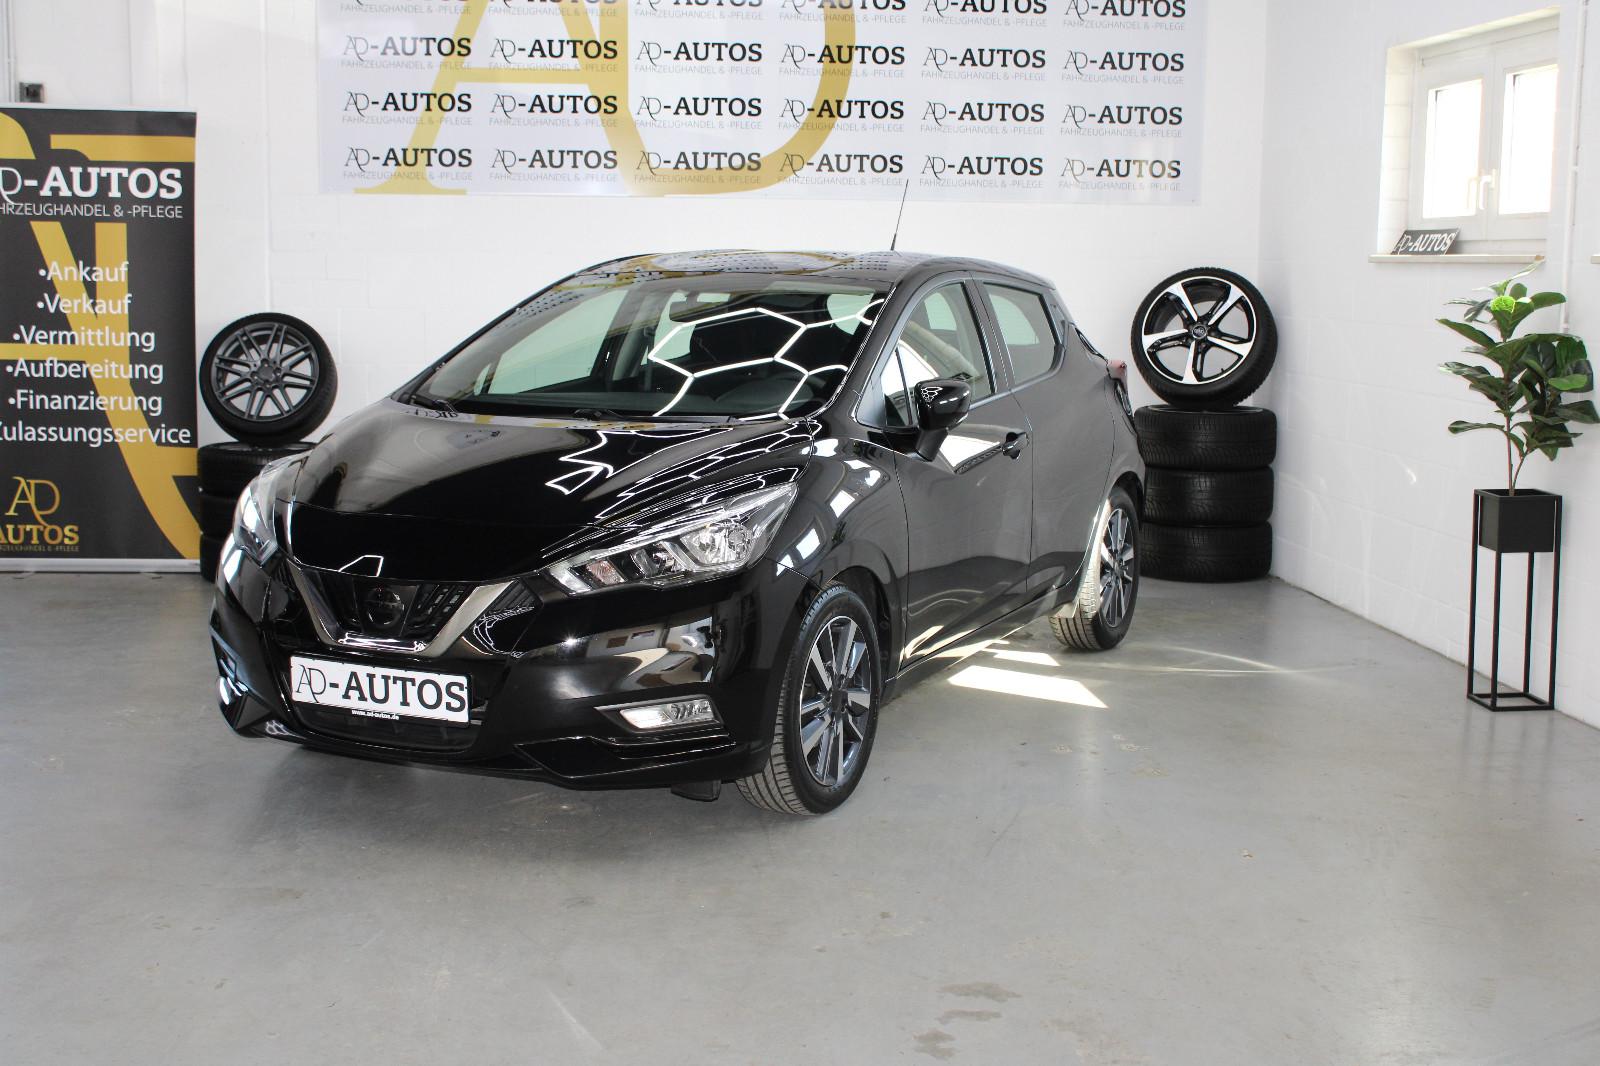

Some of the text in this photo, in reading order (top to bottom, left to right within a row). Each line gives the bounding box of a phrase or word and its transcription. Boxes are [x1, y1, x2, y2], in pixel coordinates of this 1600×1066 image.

[340, 4, 424, 14] FAHRZEUGHANDEL
[488, 6, 572, 16] FAHRZEUGHANDEL
[634, 9, 717, 19] FAHRZEUGHANDEL
[779, 12, 860, 22] FAHRZEUGHANDEL
[922, 15, 1001, 26] FAHRZEUGHANDEL
[1063, 19, 1142, 29] FAHRZEUGHANDEL
[343, 35, 471, 61] AD-AUTOS
[490, 37, 618, 63] AD-AUTOS
[636, 40, 763, 66] AD-AUTOS
[781, 43, 905, 70] AD-AUTOS
[340, 60, 425, 70] FAHRZEUGHANDEL
[488, 62, 573, 71] FAHRZEUGHANDEL
[923, 46, 1046, 72] AD-AUTOS
[1064, 50, 1185, 76] AD-AUTOS
[634, 65, 716, 74] FAHRZEUGHANDEL
[779, 68, 860, 77] FAHRZEUGHANDEL
[921, 70, 1000, 80] FAHRZEUGHANDEL
[1062, 73, 1140, 84] FAHRZEUGHANDEL
[344, 91, 472, 117] AD-AUTOS
[490, 93, 618, 119] AD-AUTOS
[637, 96, 762, 121] AD-AUTOS
[781, 99, 904, 124] AD-AUTOS
[342, 115, 427, 125] FAHRZEUGHANDEL
[489, 117, 573, 127] FAHRZEUGHANDEL
[922, 101, 1045, 126] AD-AUTOS
[1062, 104, 1183, 129] AD-AUTOS
[634, 119, 716, 129] FAHRZEUGHANDEL
[778, 122, 860, 131] FAHRZEUGHANDEL
[920, 124, 1000, 134] FAHRZEUGHANDEL
[1060, 127, 1138, 137] FAHRZEUGHANDEL
[344, 147, 472, 172] AD-AUTOS
[491, 149, 618, 174] AD-AUTOS
[636, 151, 761, 176] AD-AUTOS
[779, 153, 903, 178] AD-AUTOS
[922, 155, 1043, 181] AD-AUTOS
[343, 170, 427, 181] FAHRZEUGHANDEL
[489, 172, 573, 182] FAHRZEUGHANDEL
[634, 174, 716, 184] FAHRZEUGHANDEL
[1061, 158, 1181, 183] AD-AUTOS
[0, 166, 183, 205] D-AUTOS
[777, 176, 859, 185] FAHRZEUGHANDEL
[919, 178, 999, 188] FAHRZEUGHANDEL
[1059, 180, 1136, 191] FAHRZEUGHANDEL
[113, 205, 124, 217] &
[127, 205, 184, 219] -PFLEGE
[47, 260, 129, 282] Ankauf
[43, 293, 132, 314] Verkauf
[20, 325, 156, 352] Vermittlung
[13, 358, 164, 385] Aufbereitung
[16, 389, 163, 416] Finanzierung
[296, 664, 466, 713] AD-AUTOS
